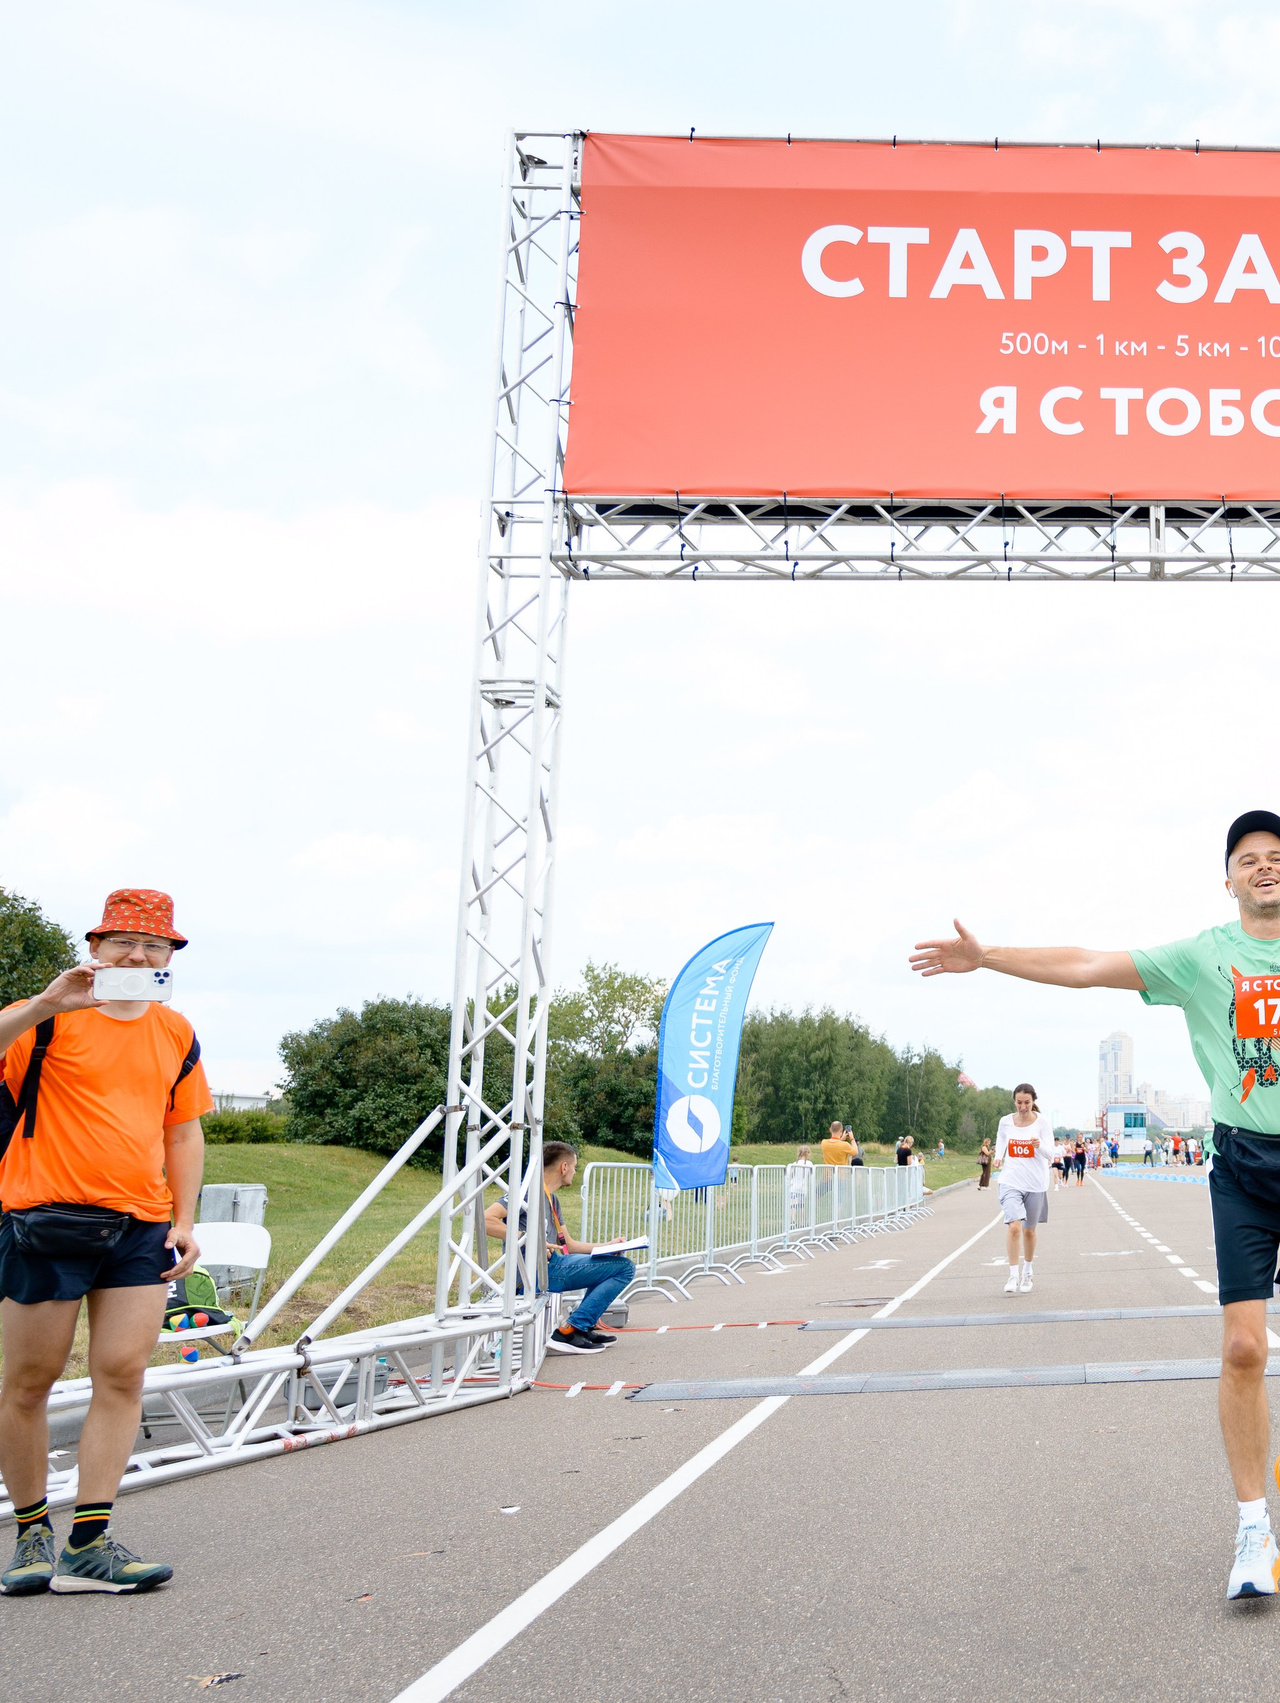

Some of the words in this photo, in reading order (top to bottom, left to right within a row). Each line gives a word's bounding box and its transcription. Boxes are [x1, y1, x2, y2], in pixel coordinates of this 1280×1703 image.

[801, 224, 1132, 302] СТАРТ
[999, 332, 1069, 356] 500м
[1095, 333, 1105, 356] 1
[1115, 340, 1147, 356] км
[1174, 334, 1190, 357] 5
[1198, 342, 1230, 357] км
[975, 385, 1018, 435] Я
[1039, 385, 1085, 436] С
[1241, 981, 1250, 992] Я
[1253, 980, 1262, 991] С
[687, 958, 733, 1088] СИСТЕМА
[711, 985, 735, 1090] БЛАГОТВОРИТЕЛЬНЫЙ
[1273, 1028, 1278, 1036] 5
[1013, 1146, 1030, 1154] 106
